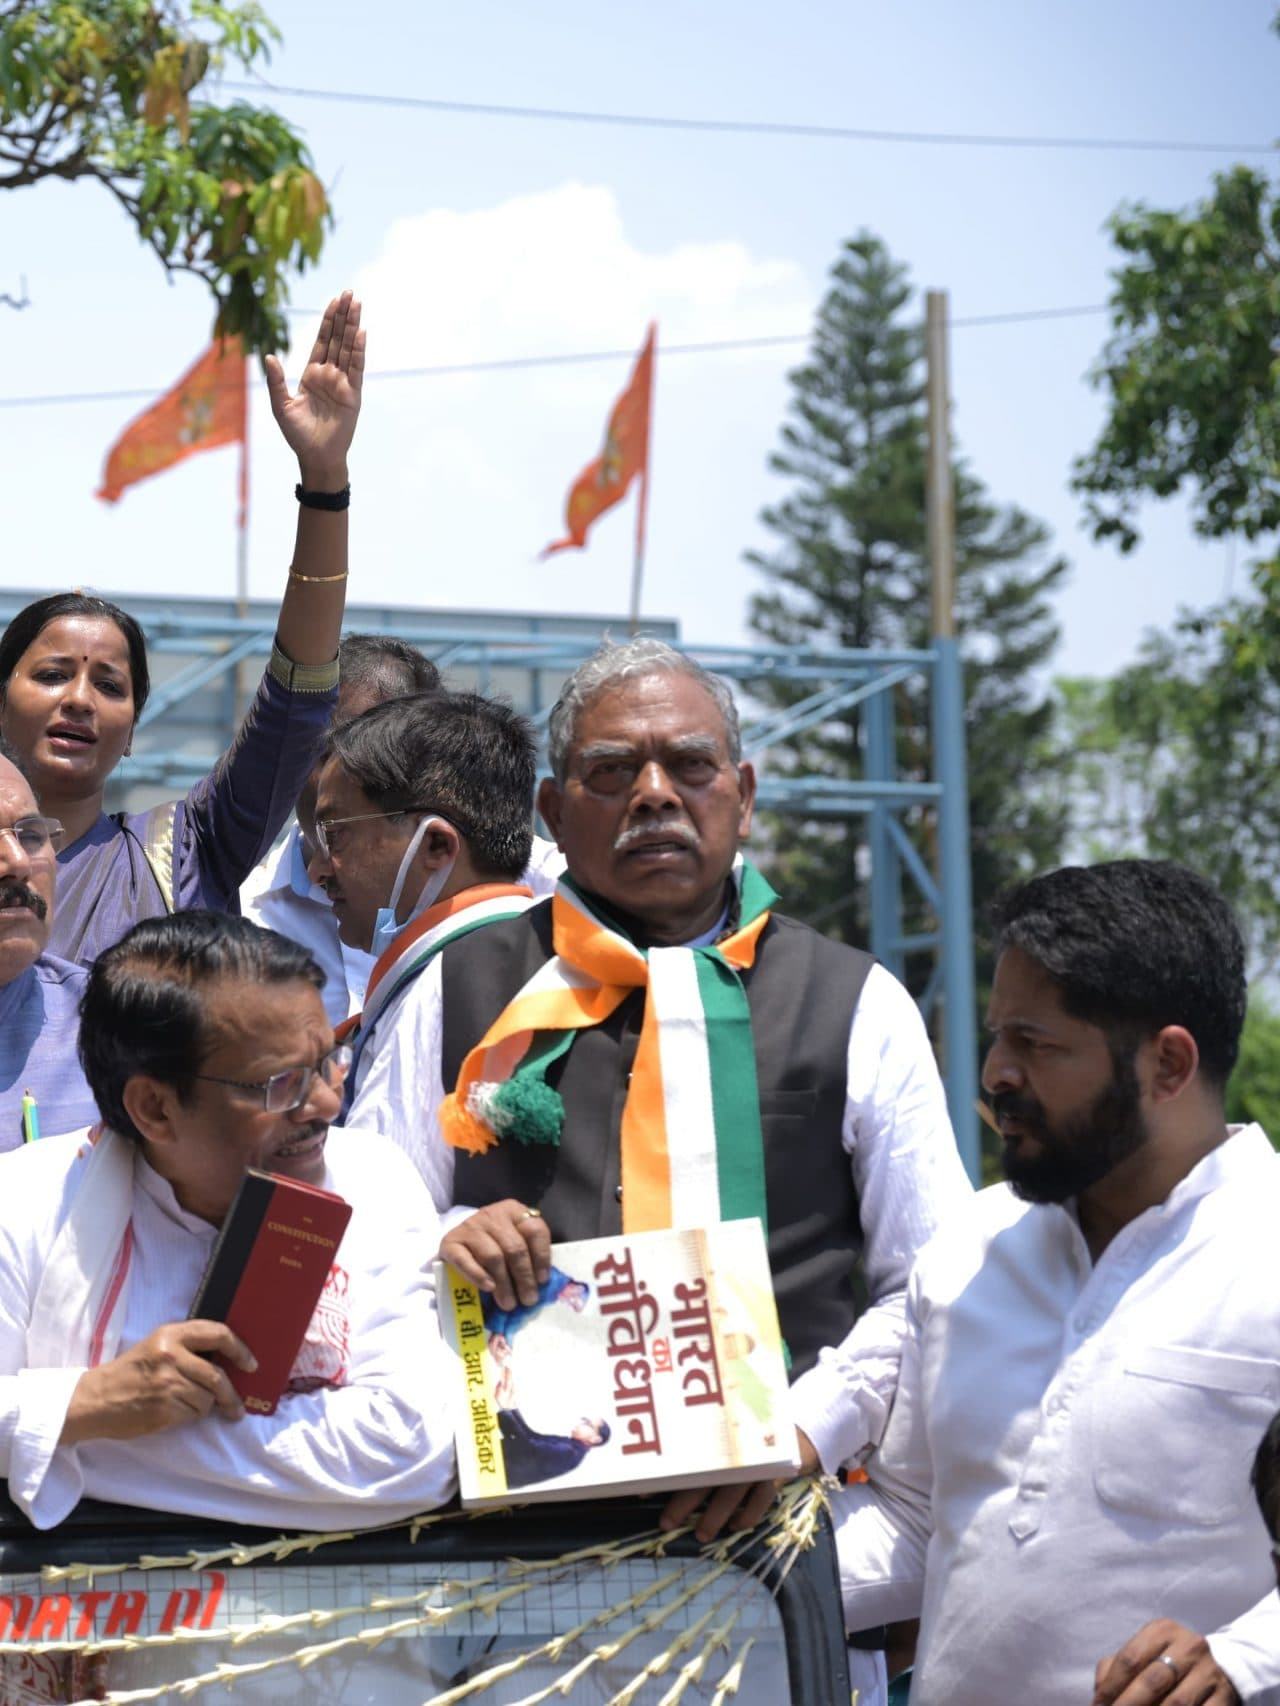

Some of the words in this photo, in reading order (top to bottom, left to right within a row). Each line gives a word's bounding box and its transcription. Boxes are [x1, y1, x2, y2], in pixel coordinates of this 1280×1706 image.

[593, 1247, 662, 1456] संविधान
[651, 1337, 673, 1373] का
[670, 1277, 725, 1407] भारत
[158, 1571, 226, 1633] DI
